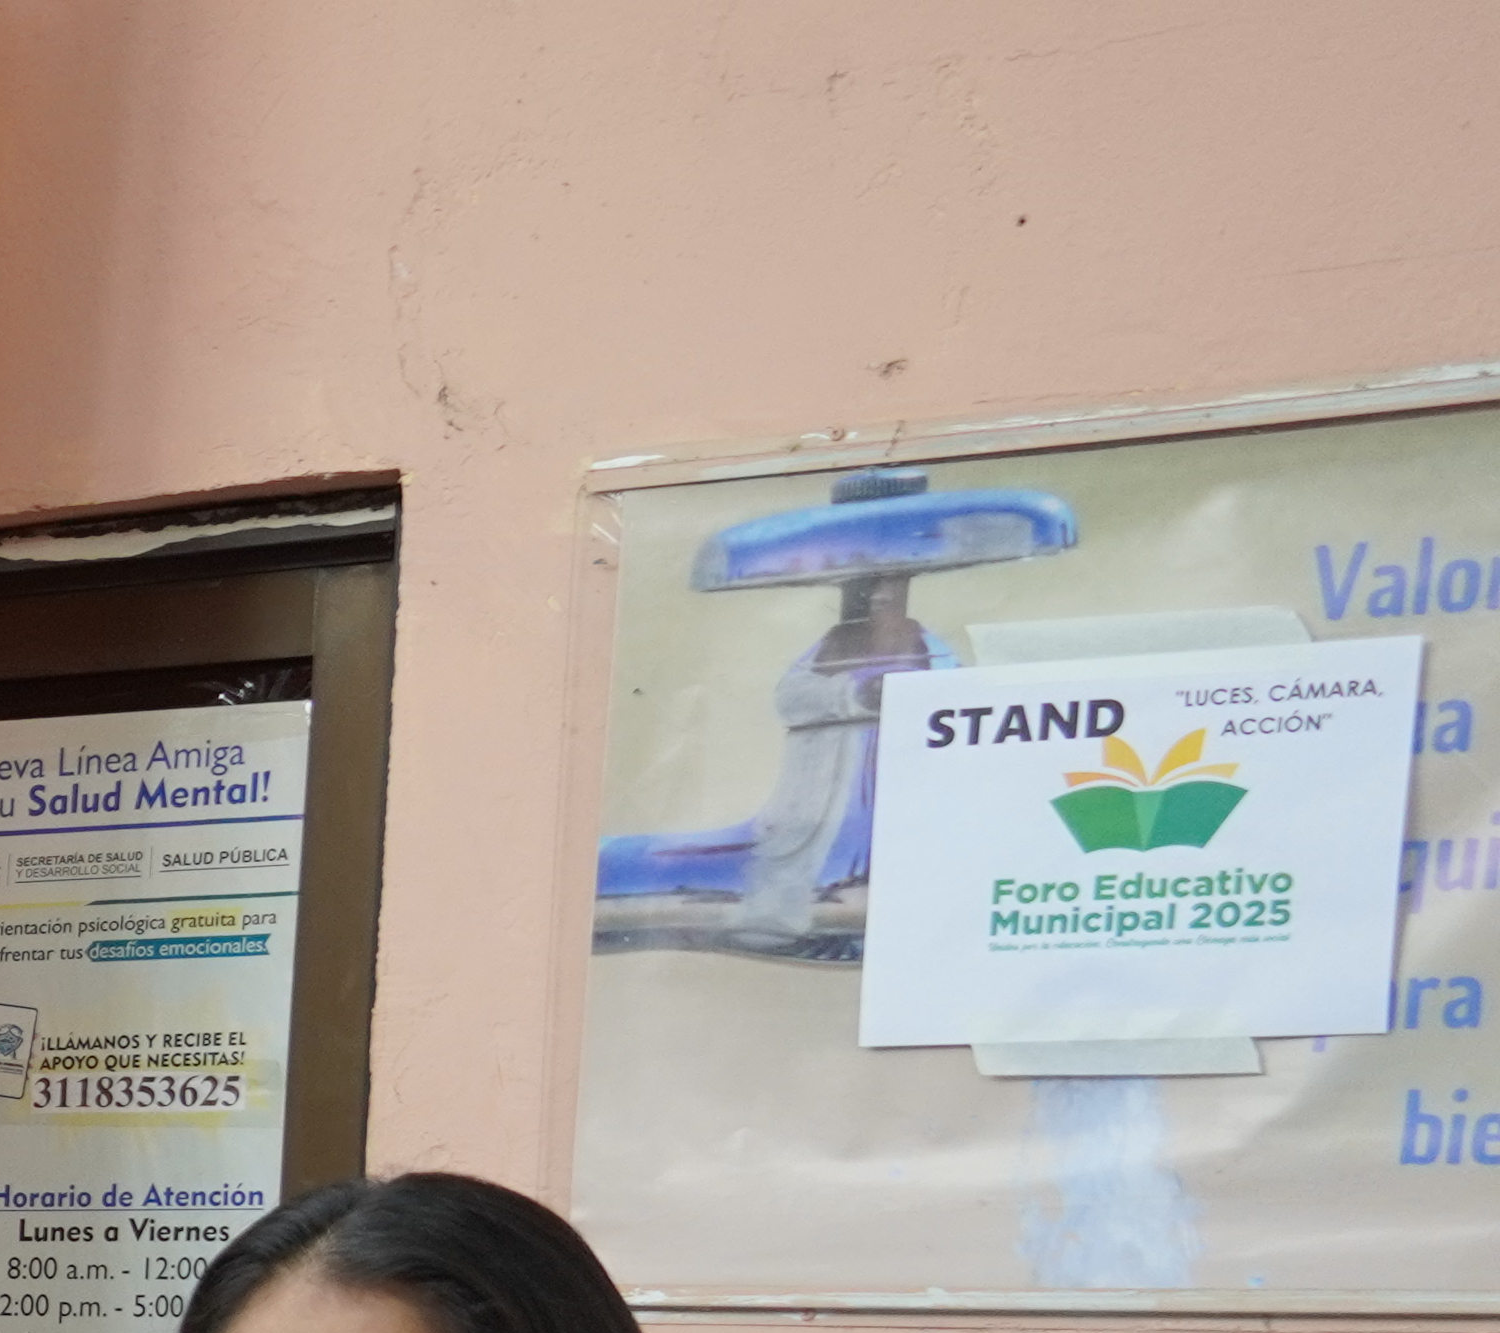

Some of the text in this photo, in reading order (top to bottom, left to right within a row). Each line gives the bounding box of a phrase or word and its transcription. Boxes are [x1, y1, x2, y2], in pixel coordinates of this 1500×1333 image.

[1268, 678, 1385, 702] CÁMARA,
[925, 698, 1126, 749] STAND
[58, 745, 138, 777] Línea
[146, 739, 245, 776] Amiga
[28, 780, 122, 816] Salud
[134, 771, 272, 810] Mental!
[16, 850, 143, 867] SECRETARÍA DE SALUD
[162, 847, 288, 867] SALUD PÚBLICA
[15, 863, 141, 878] Y DESARROLLO SOCIAL
[990, 868, 1293, 906] Foro Educativo
[78, 914, 166, 937] psicológica
[170, 912, 236, 933] gratuita
[242, 913, 277, 930] para
[989, 899, 1292, 938] Municipal 2025
[60, 948, 83, 960] tus
[88, 940, 155, 958] desafíos
[40, 1031, 247, 1051] ¡LLÁMANOS Y RECIBE EL
[39, 1055, 98, 1071] APOYO
[104, 1054, 141, 1072] QUE
[147, 1051, 245, 1068] NECESITAS!
[32, 1075, 240, 1108] 3118353625
[101, 1183, 134, 1207] de
[141, 1182, 264, 1207] Atención
[18, 1217, 230, 1242] Lunes a Viernes
[7, 1257, 58, 1280] 8:00
[66, 1263, 115, 1280] a.m.
[144, 1257, 208, 1280] 12:00
[0, 1294, 49, 1317] 2:00
[58, 1300, 108, 1324] p.m.
[132, 1294, 184, 1317] 5:00
